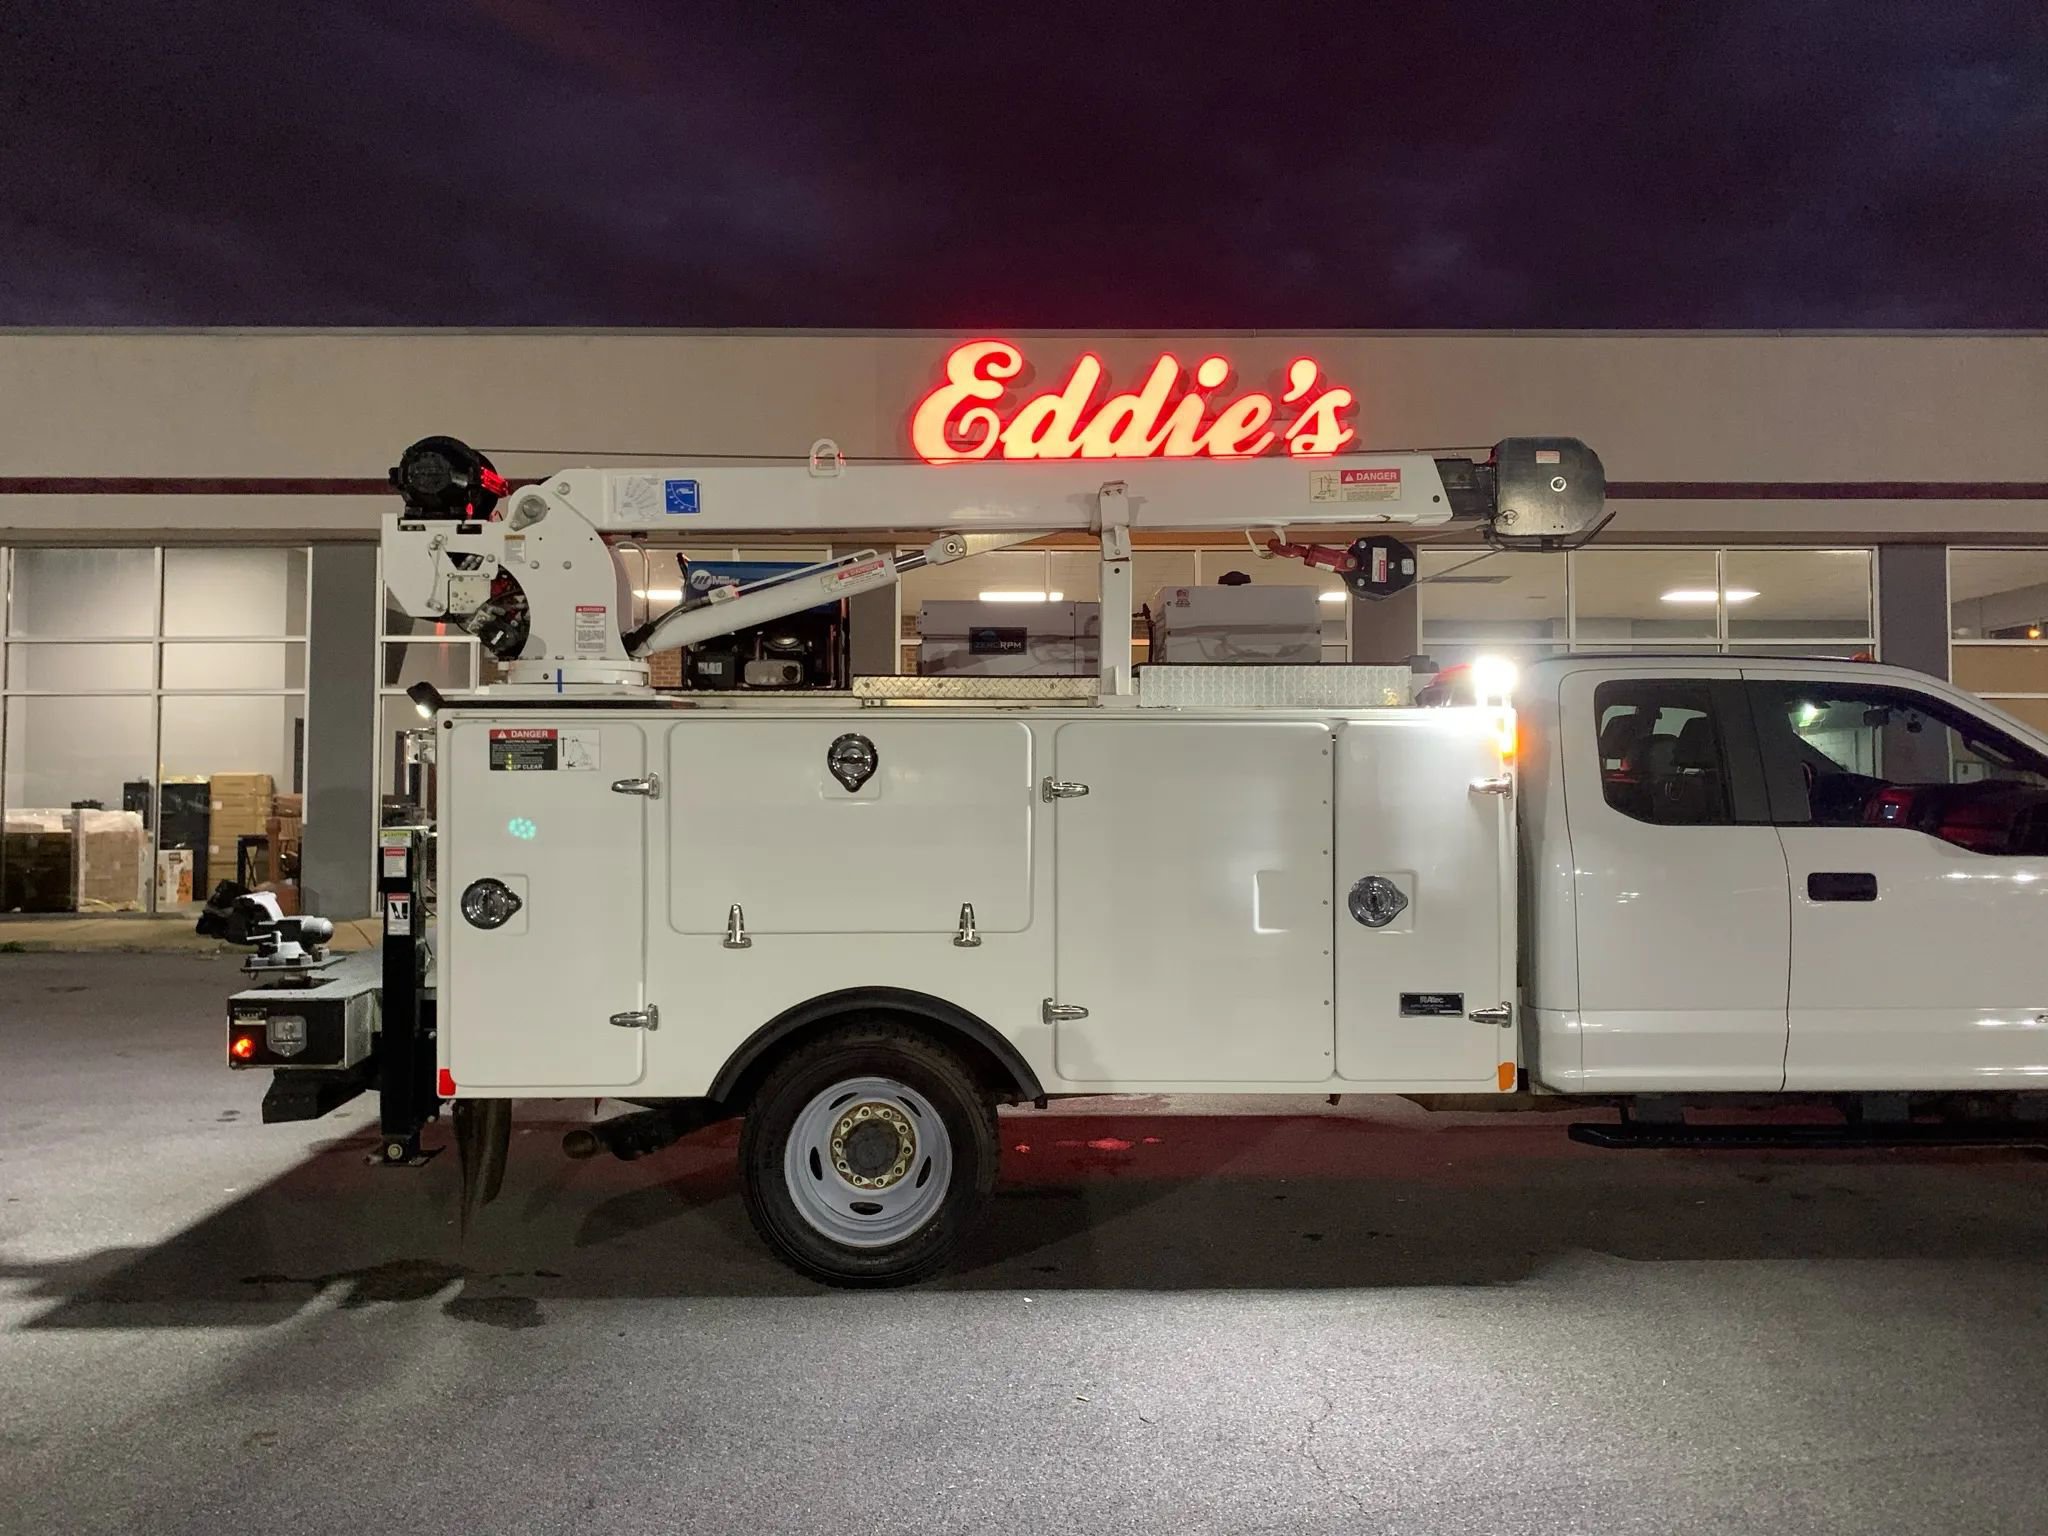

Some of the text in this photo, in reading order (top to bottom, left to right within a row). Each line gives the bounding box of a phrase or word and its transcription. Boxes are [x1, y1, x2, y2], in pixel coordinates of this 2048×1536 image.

[912, 339, 1355, 463] Eddie's
[1356, 472, 1397, 481] DANGER
[511, 730, 549, 739] DANGER
